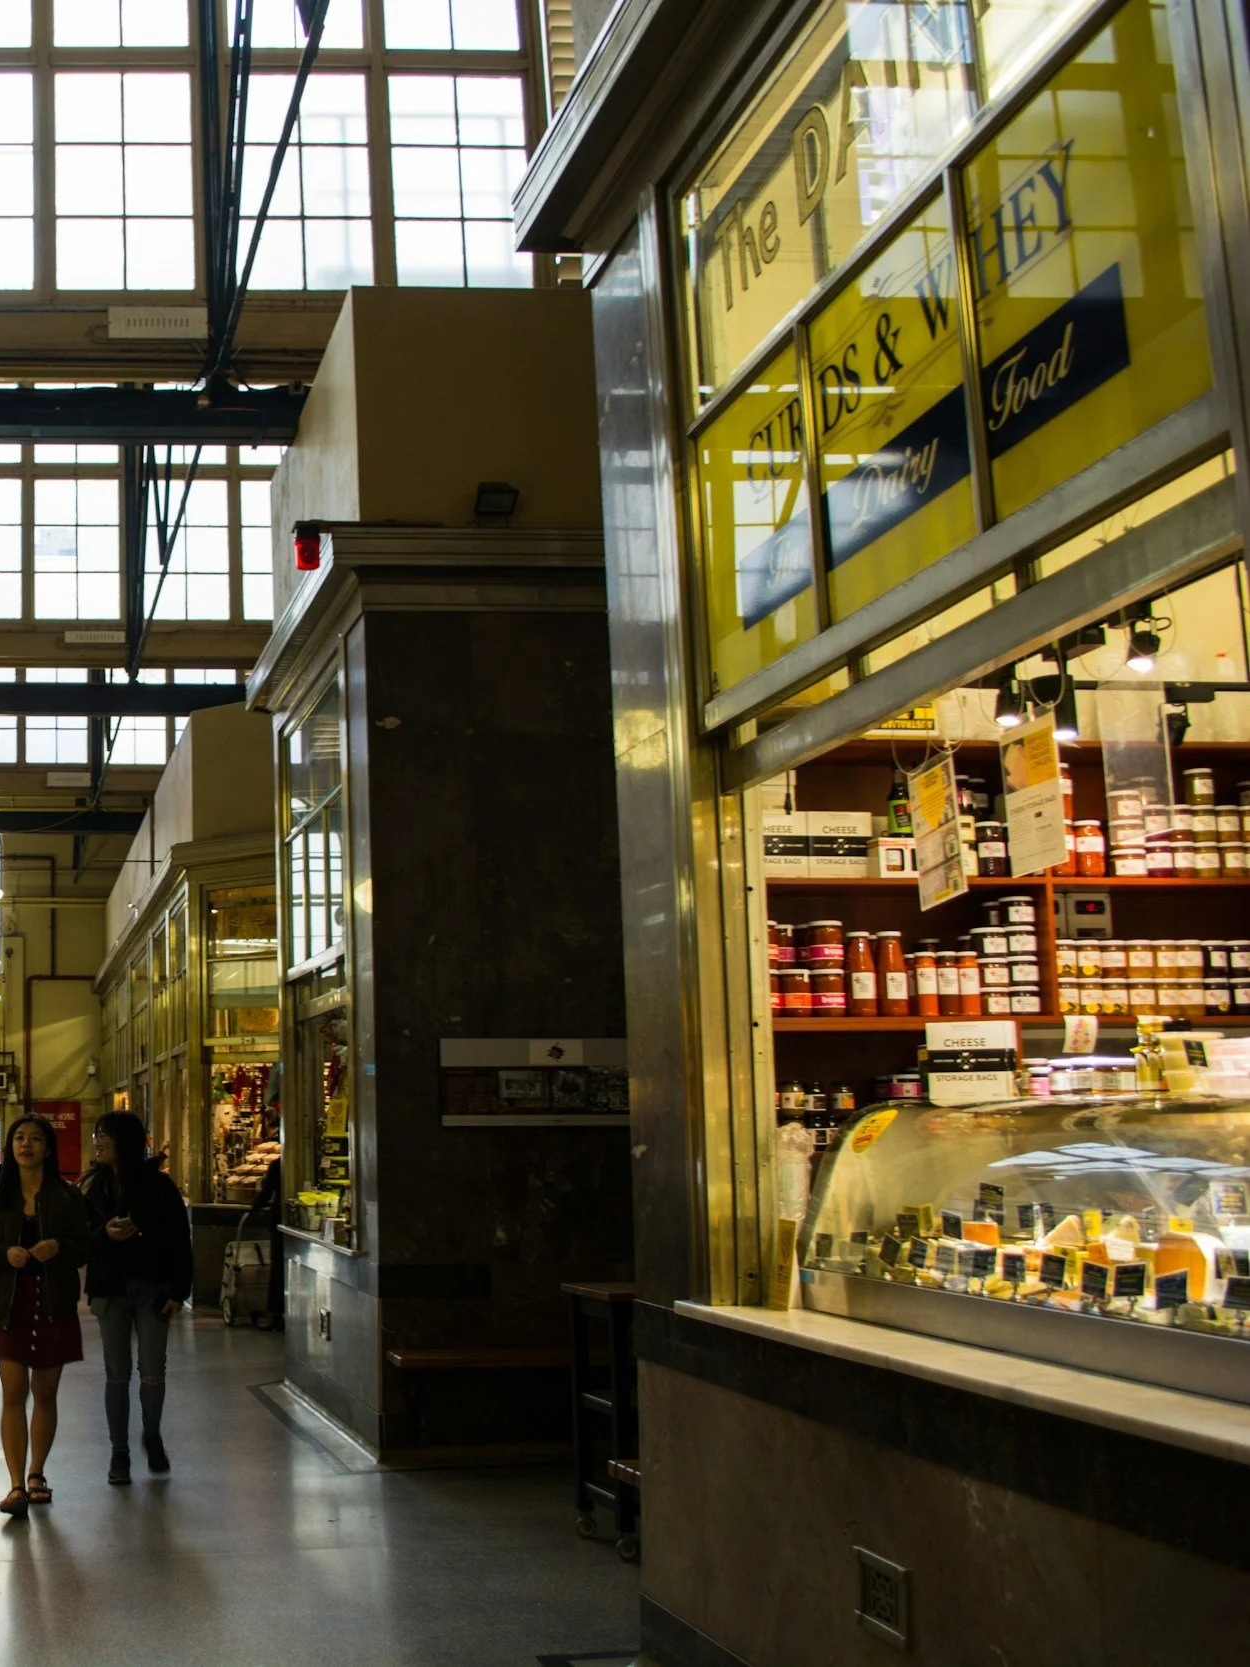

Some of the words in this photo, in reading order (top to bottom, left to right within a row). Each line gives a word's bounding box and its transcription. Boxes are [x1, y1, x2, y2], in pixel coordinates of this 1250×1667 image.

[715, 198, 780, 312] The
[873, 313, 904, 386] &
[913, 138, 1075, 344] WHEY
[850, 436, 939, 530] Dairy
[988, 321, 1075, 431] Food
[763, 825, 792, 834] HEESE
[822, 826, 858, 834] CHEESE
[816, 858, 847, 866] STORAGE
[944, 1038, 987, 1048] CHEESE
[936, 1073, 975, 1082] STORAGE
[977, 1073, 998, 1082] BAGS
[56, 1112, 76, 1121] HOSE
